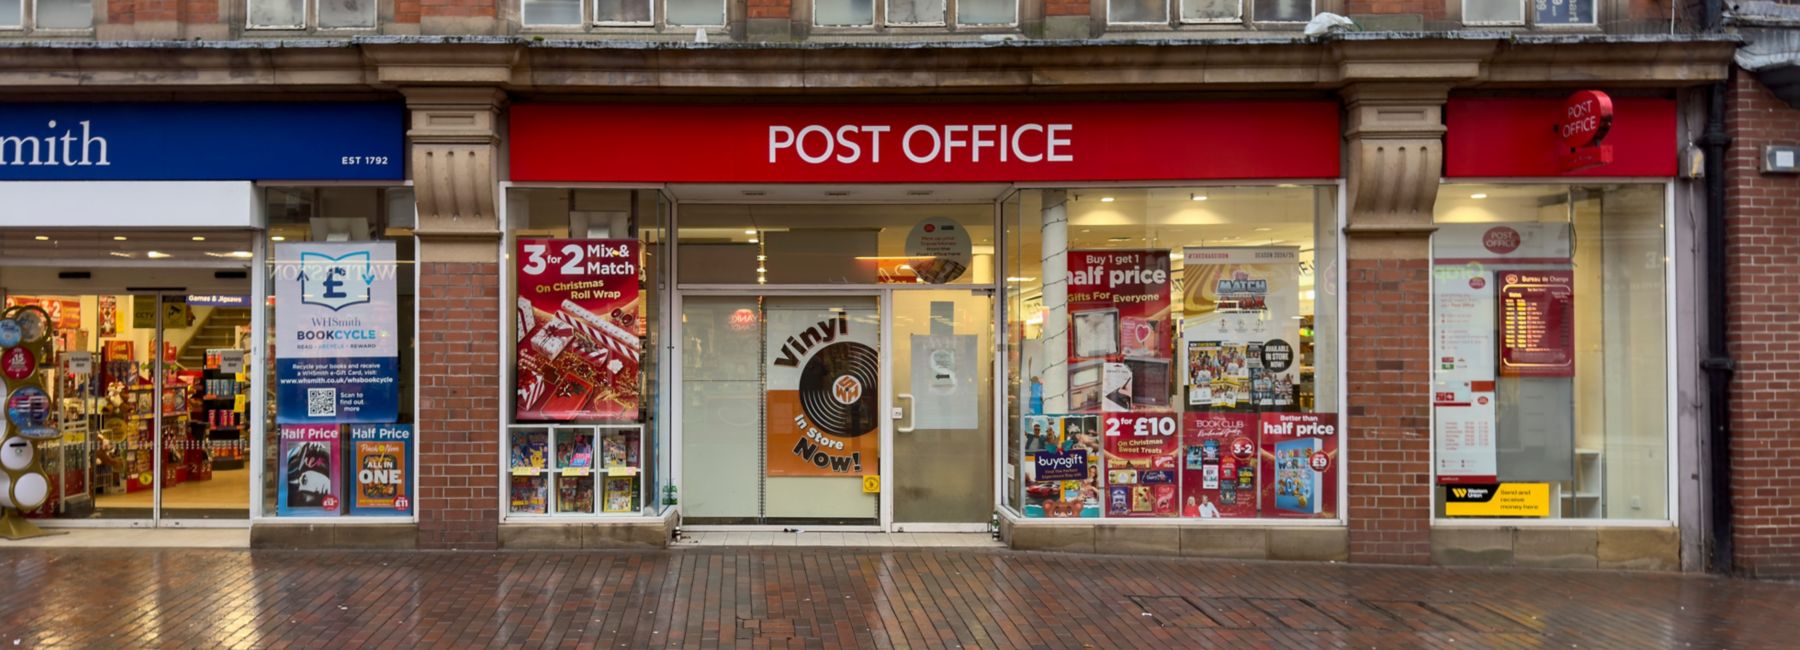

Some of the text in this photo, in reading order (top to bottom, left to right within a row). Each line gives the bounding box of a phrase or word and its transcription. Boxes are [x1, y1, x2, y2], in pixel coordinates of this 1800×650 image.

[1567, 100, 1593, 118] POST
[1563, 116, 1596, 138] OFFICE
[769, 123, 1074, 164] POST OFFICE
[341, 156, 388, 165] EST 1792
[1486, 239, 1517, 247] OFFICE
[587, 244, 629, 257] Mix &
[522, 244, 585, 275] 3 for 2
[1086, 255, 1139, 265] Buy 1 get 1
[587, 262, 634, 275] Match
[1109, 266, 1167, 288] price
[535, 280, 604, 293] On Christmas
[1218, 280, 1267, 293] MATCH
[571, 290, 621, 299] Roll Wrap
[1067, 291, 1160, 303] Gifts For Everyone
[312, 317, 362, 327] WHSmith
[297, 330, 376, 340] BOOKCYCLE
[774, 311, 848, 368] Vinyl
[1106, 416, 1176, 436] 2 for £10
[1196, 420, 1244, 428] BOOK CLUB
[1263, 422, 1335, 437] half price
[281, 428, 338, 439] Half Price
[352, 428, 410, 438] Half Price
[806, 427, 844, 450] Store
[792, 437, 862, 473] Now!
[1234, 443, 1252, 454] 3-2
[1038, 454, 1083, 469] buyagift
[1312, 457, 1327, 467] £9
[359, 469, 402, 484] ONE
